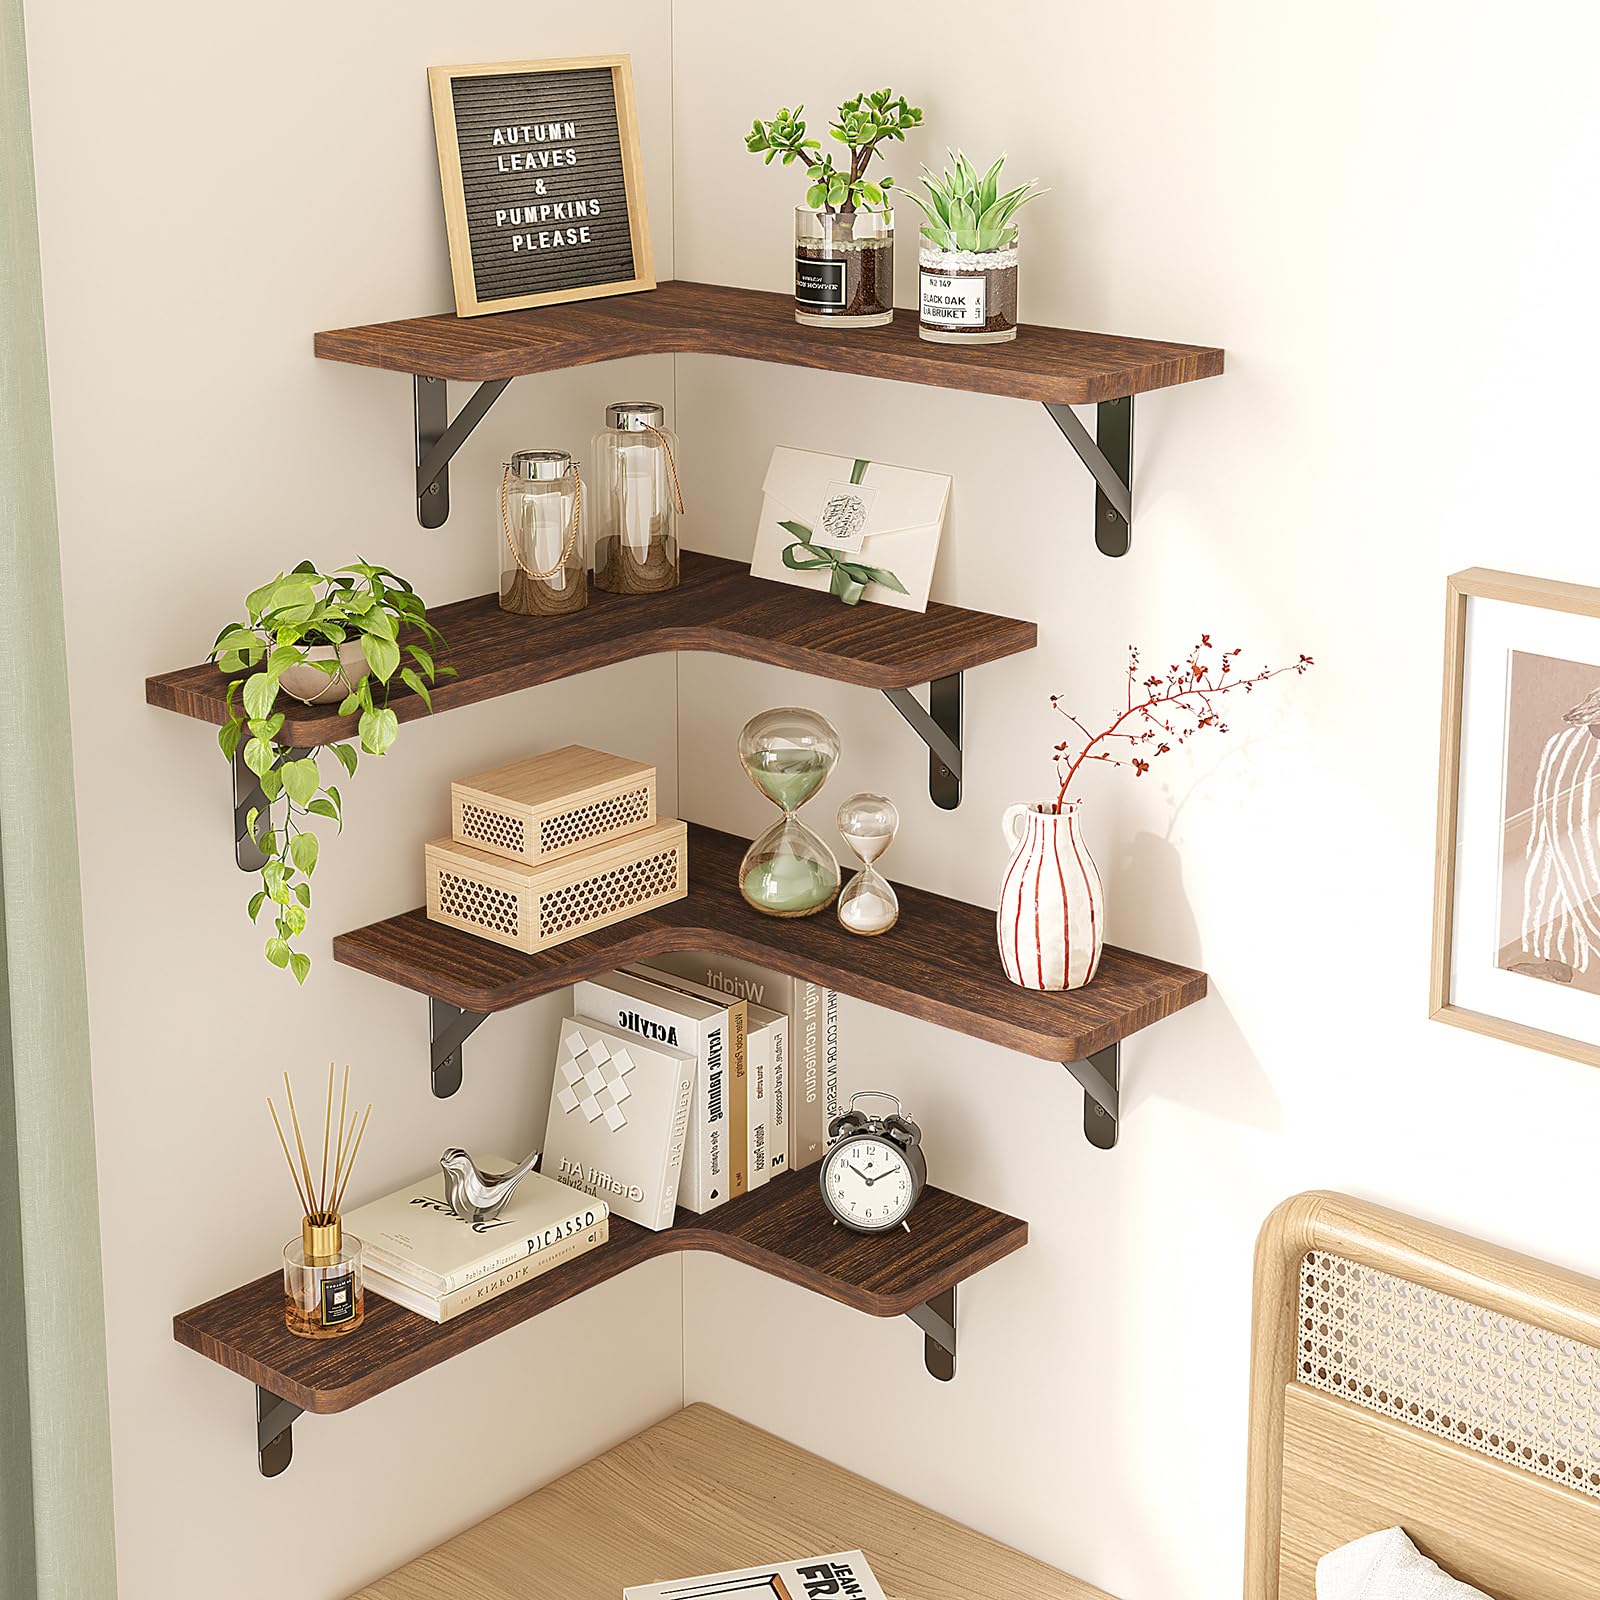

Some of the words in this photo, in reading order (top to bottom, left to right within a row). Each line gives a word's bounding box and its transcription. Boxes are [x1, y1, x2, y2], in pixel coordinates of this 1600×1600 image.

[492, 122, 577, 146] AUTUMN
[497, 148, 577, 172] LEAVES
[535, 178, 548, 195] &
[495, 199, 601, 227] PUMPKINS
[512, 226, 591, 252] PLEASE
[923, 293, 943, 304] BLACK
[944, 296, 966, 305] OAK
[932, 309, 968, 319] BRUKET
[852, 1149, 860, 1158] 11
[866, 1146, 876, 1156] 12
[840, 1159, 849, 1168] 10
[894, 1163, 901, 1173] 2
[834, 1174, 841, 1183] 9
[898, 1180, 905, 1190] 3
[838, 1190, 845, 1199] 8
[893, 1196, 899, 1205] 4
[850, 1202, 857, 1211] 7
[882, 1205, 889, 1215] 5
[865, 1208, 872, 1218] 6
[527, 1211, 595, 1255] PICASSO
[496, 1253, 518, 1267] Picasso
[796, 1563, 840, 1600] FR
[830, 1562, 867, 1600] JEAN-
